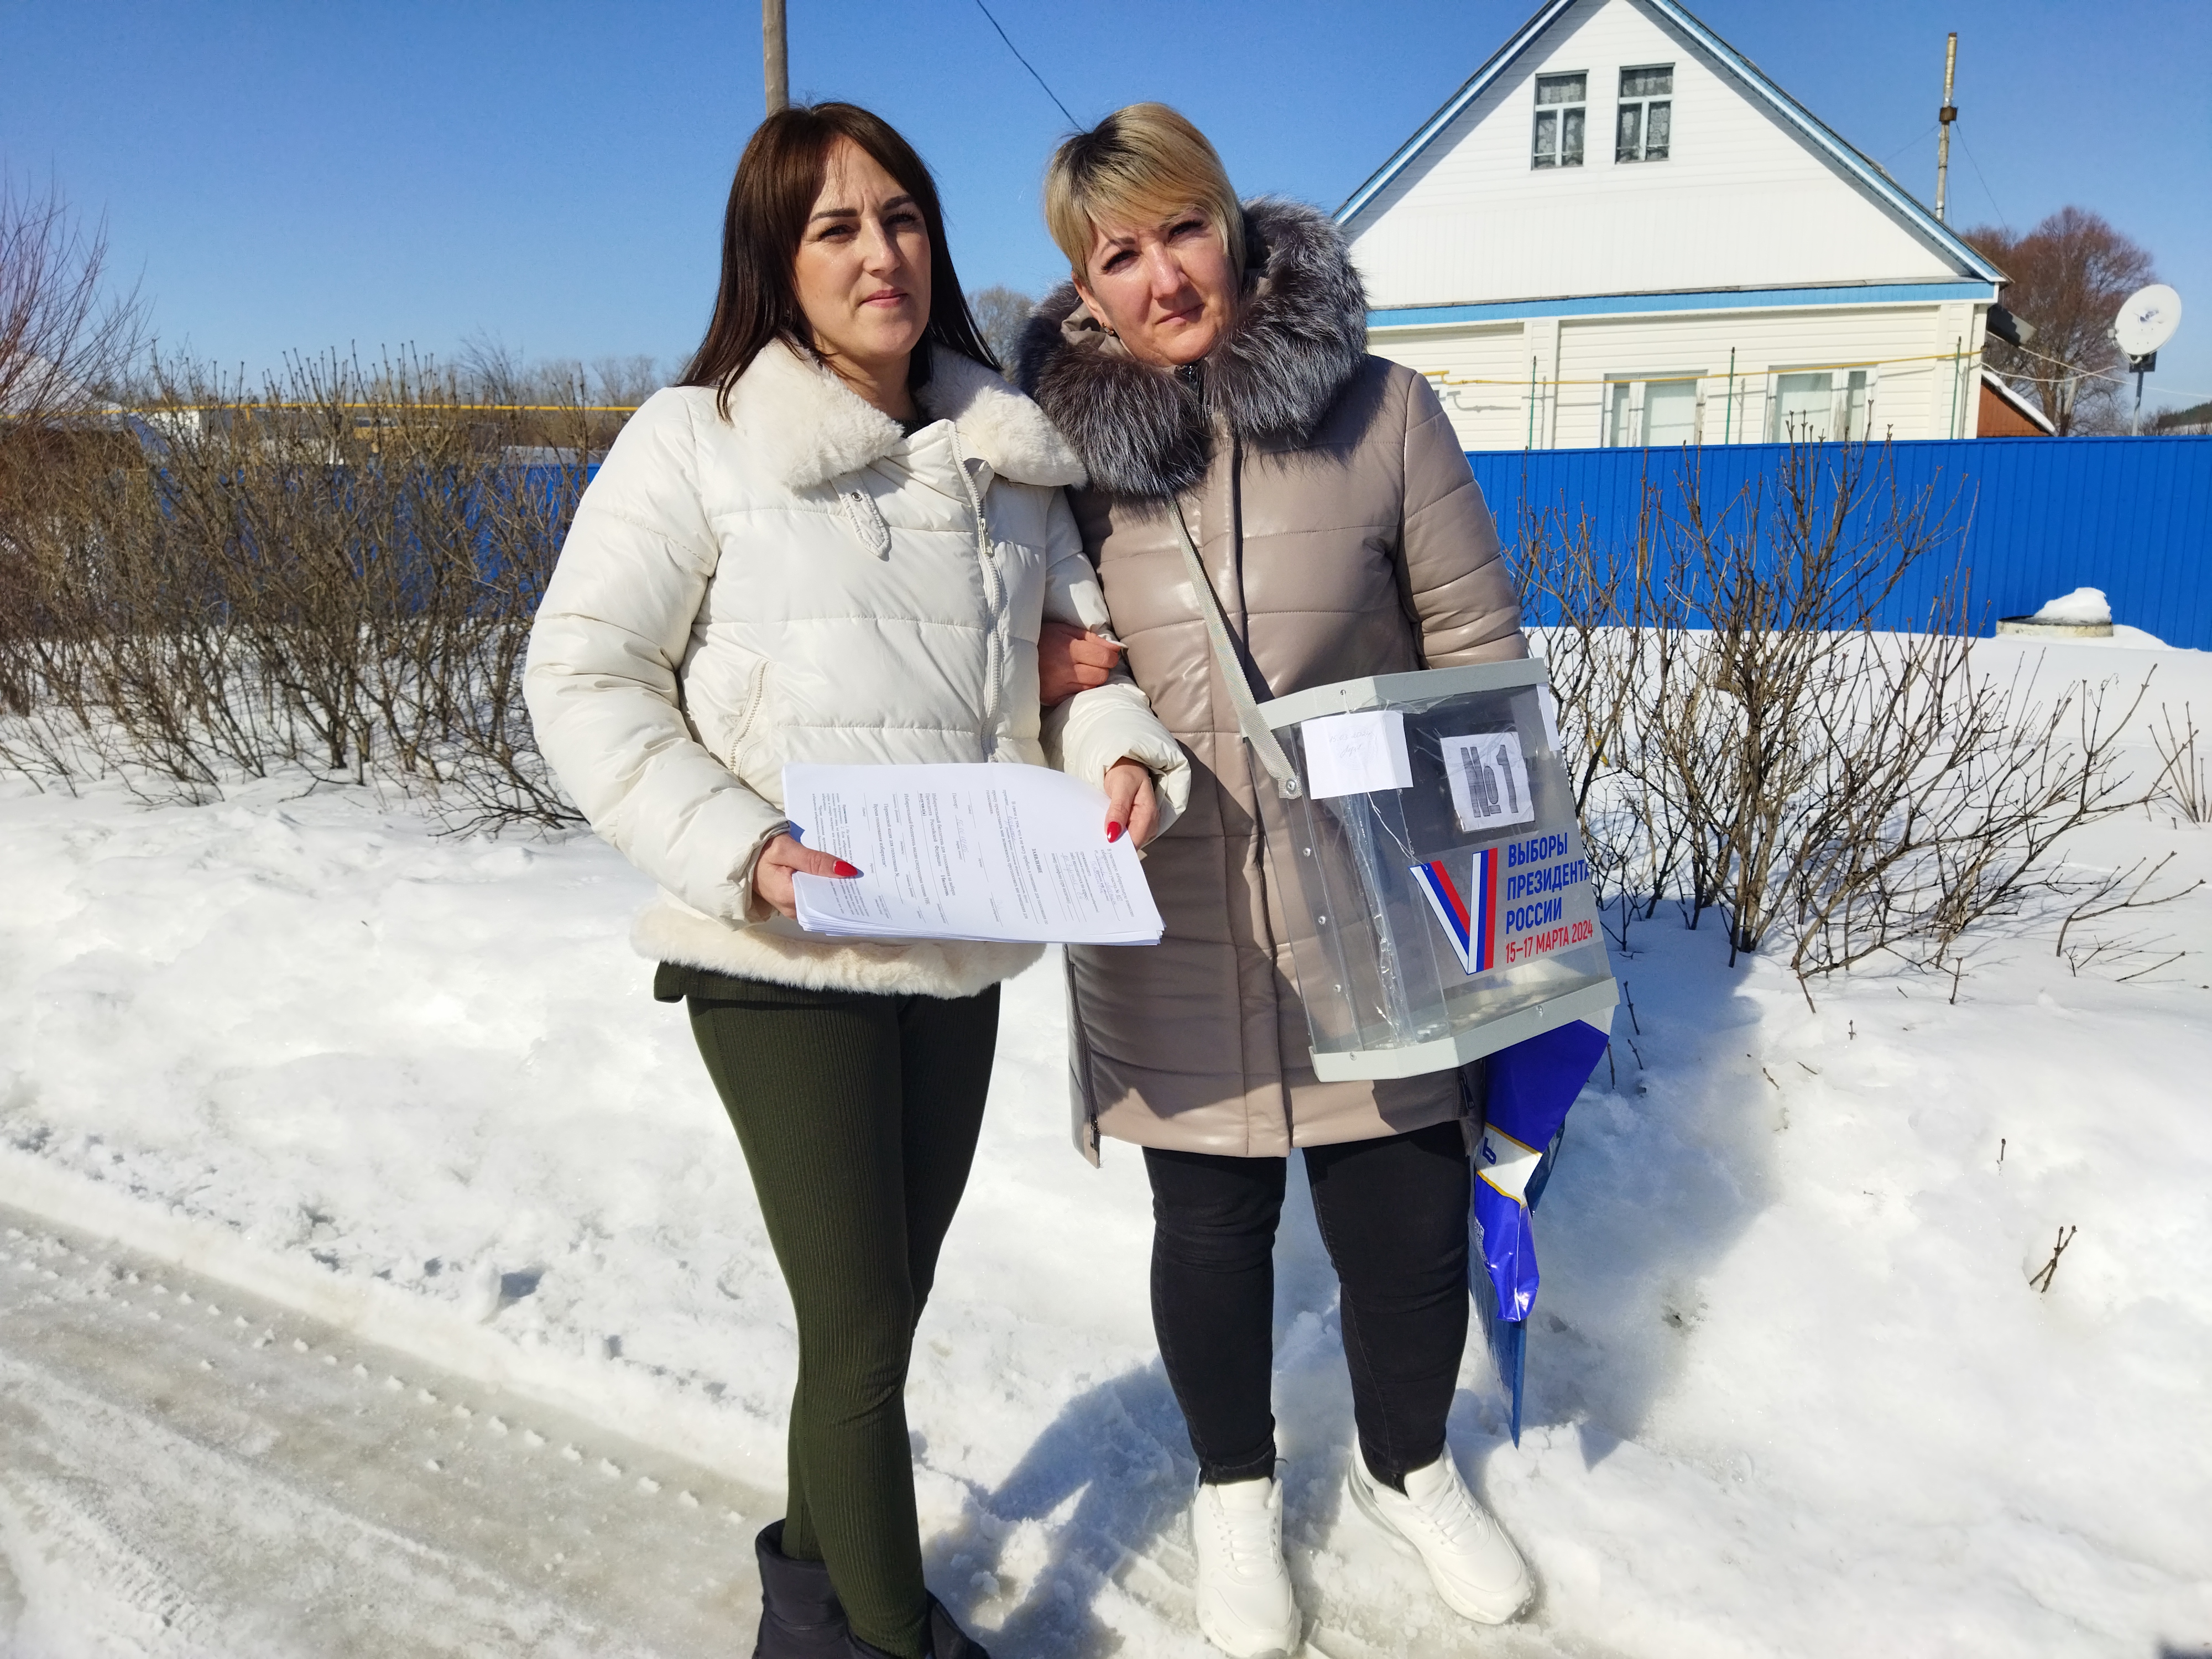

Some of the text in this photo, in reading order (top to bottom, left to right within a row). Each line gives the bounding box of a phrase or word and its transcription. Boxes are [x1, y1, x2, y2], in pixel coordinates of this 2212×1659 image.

[883, 804, 891, 827] Переносной
[1032, 848, 1042, 873] ЗАЯВЛЕНИЕ
[1508, 832, 1567, 868] ВЫБОРЫ
[1507, 859, 1590, 901] ПРЕЗИДЕНТА
[1506, 897, 1562, 935] РОССИИ
[1536, 926, 1569, 954] МАРТА
[1572, 919, 1593, 943] 2024
